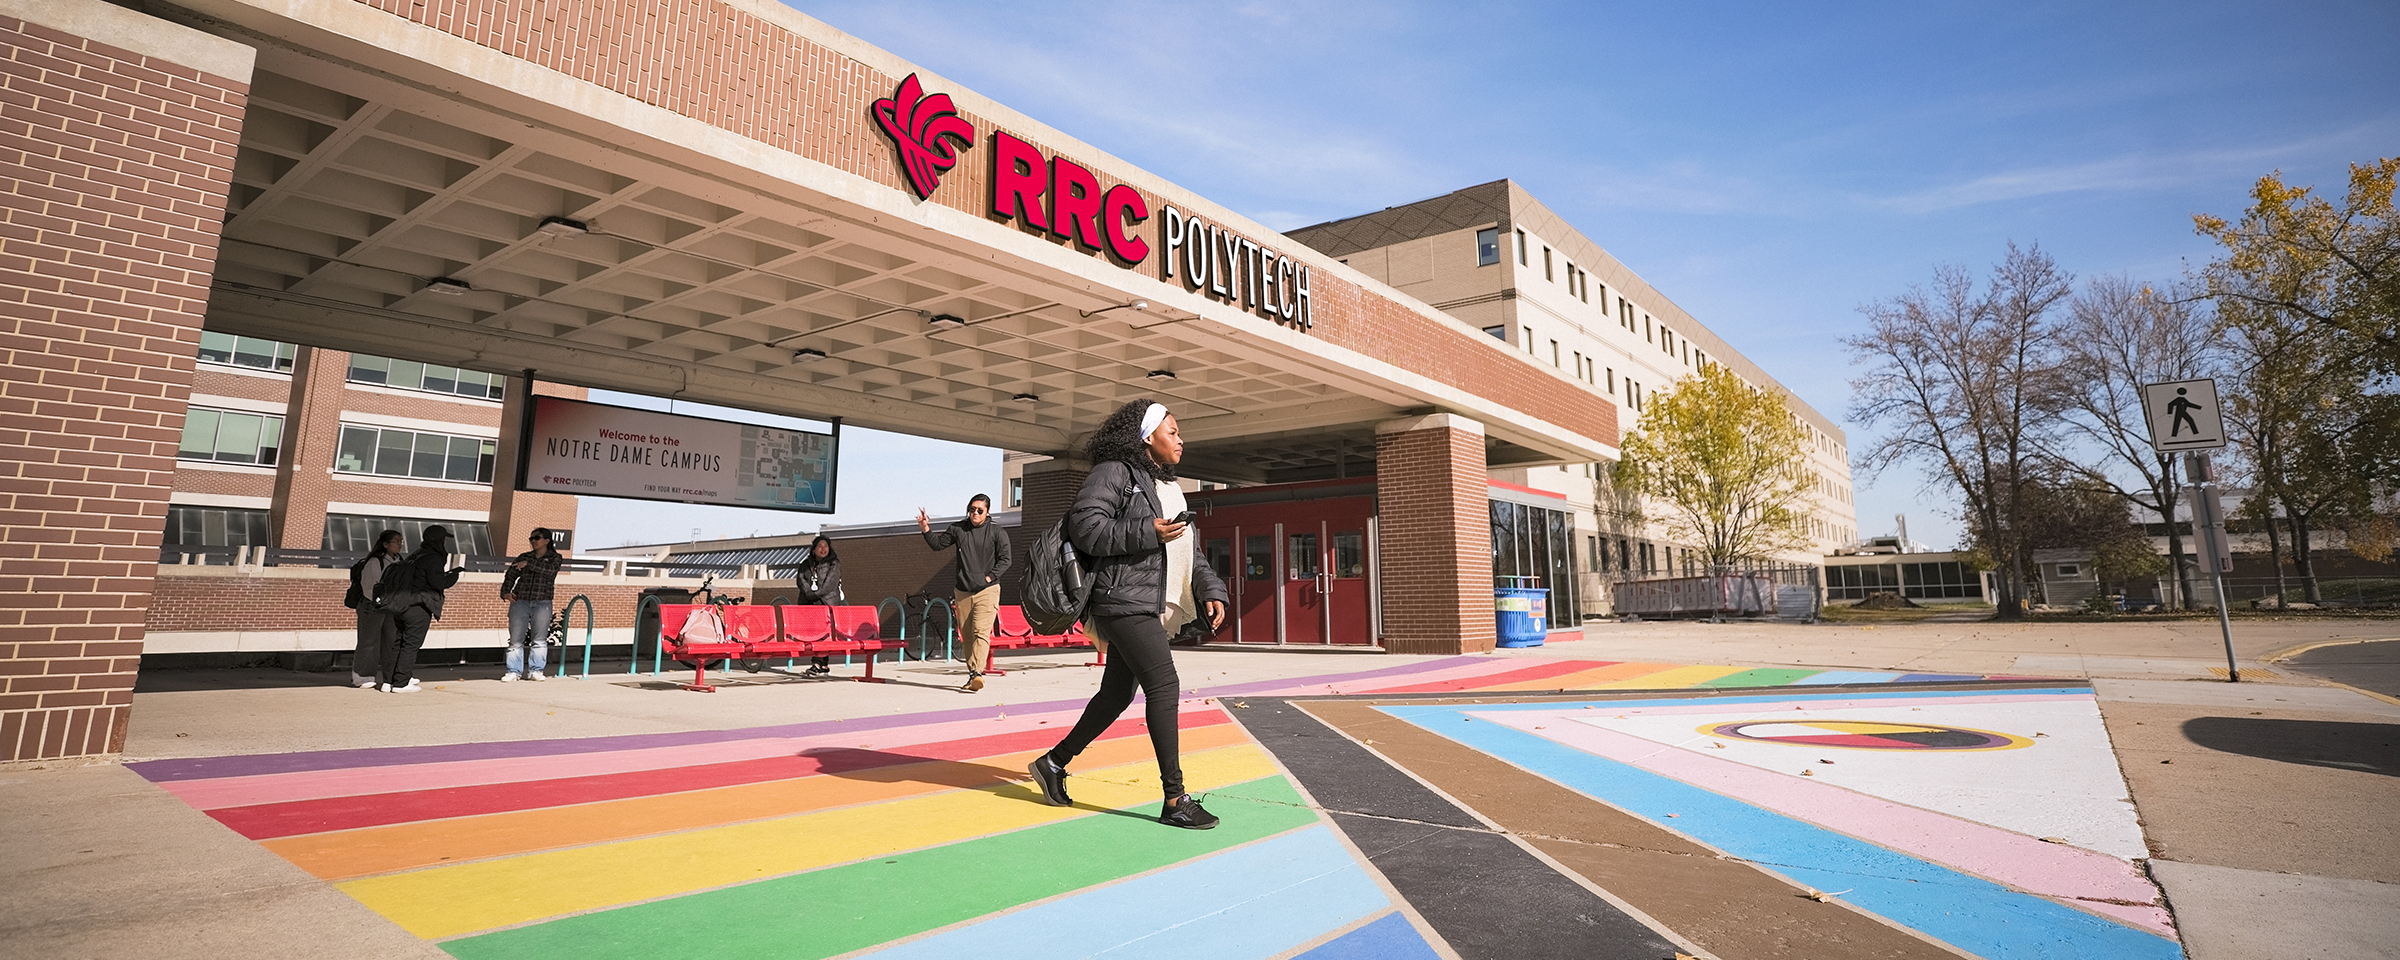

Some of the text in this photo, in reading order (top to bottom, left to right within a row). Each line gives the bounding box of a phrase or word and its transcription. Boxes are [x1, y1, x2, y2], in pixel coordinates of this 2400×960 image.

[991, 129, 1313, 329] RRC POLYTECH
[599, 428, 680, 447] Welcome to the
[546, 437, 602, 461] NOTRE
[610, 444, 653, 466] DAME
[661, 449, 721, 473] CAMPUS
[553, 476, 597, 487] RRC POLYTECH
[644, 484, 718, 498] FIND YOUR WAY rrc.ca/maps
